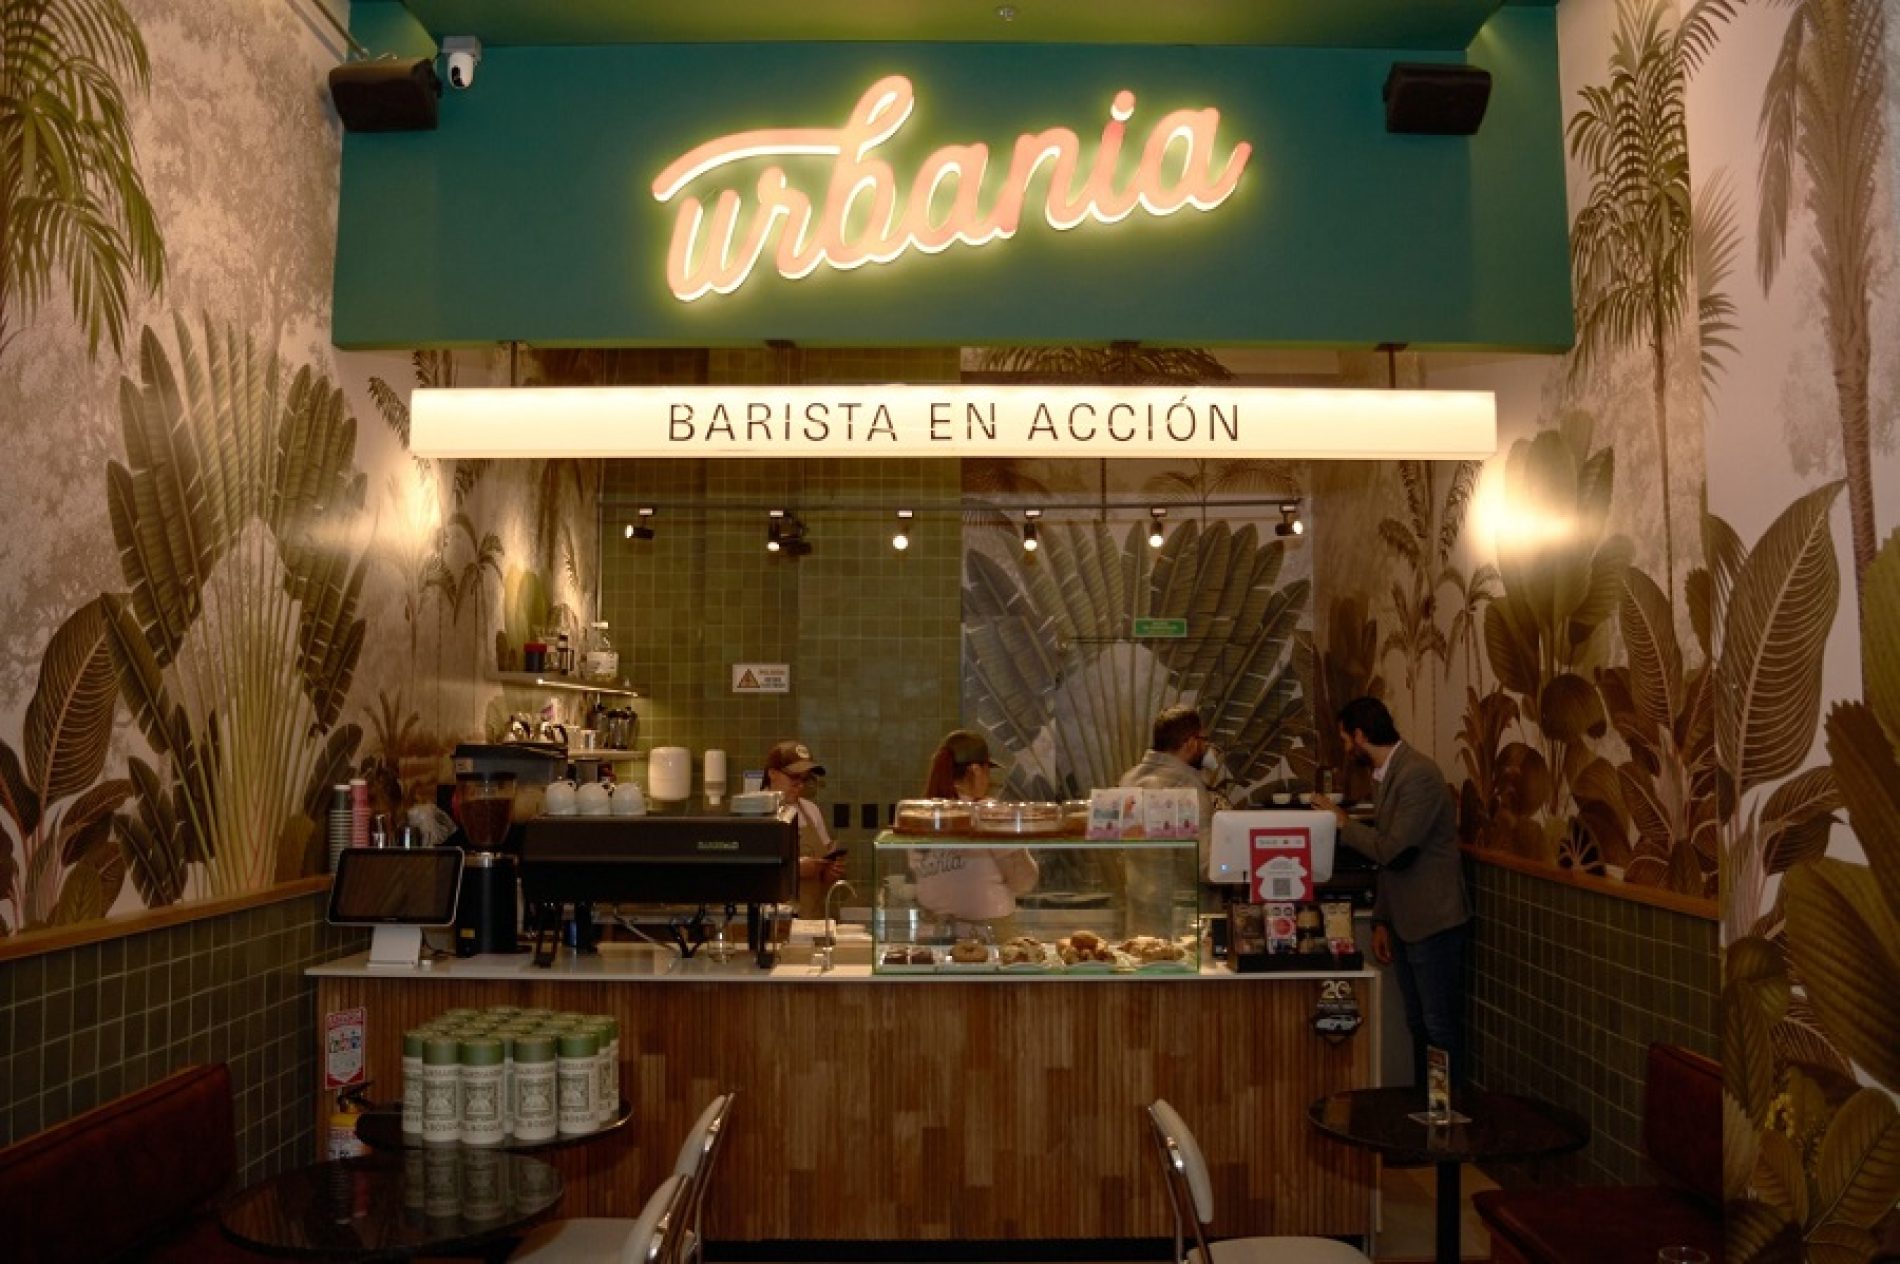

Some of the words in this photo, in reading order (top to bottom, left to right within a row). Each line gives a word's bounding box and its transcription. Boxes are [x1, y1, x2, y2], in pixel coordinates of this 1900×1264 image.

[652, 75, 1252, 302] urbania
[669, 403, 898, 441] BARISTA
[930, 403, 996, 441] EN
[1027, 395, 1238, 441] ACCIÓN
